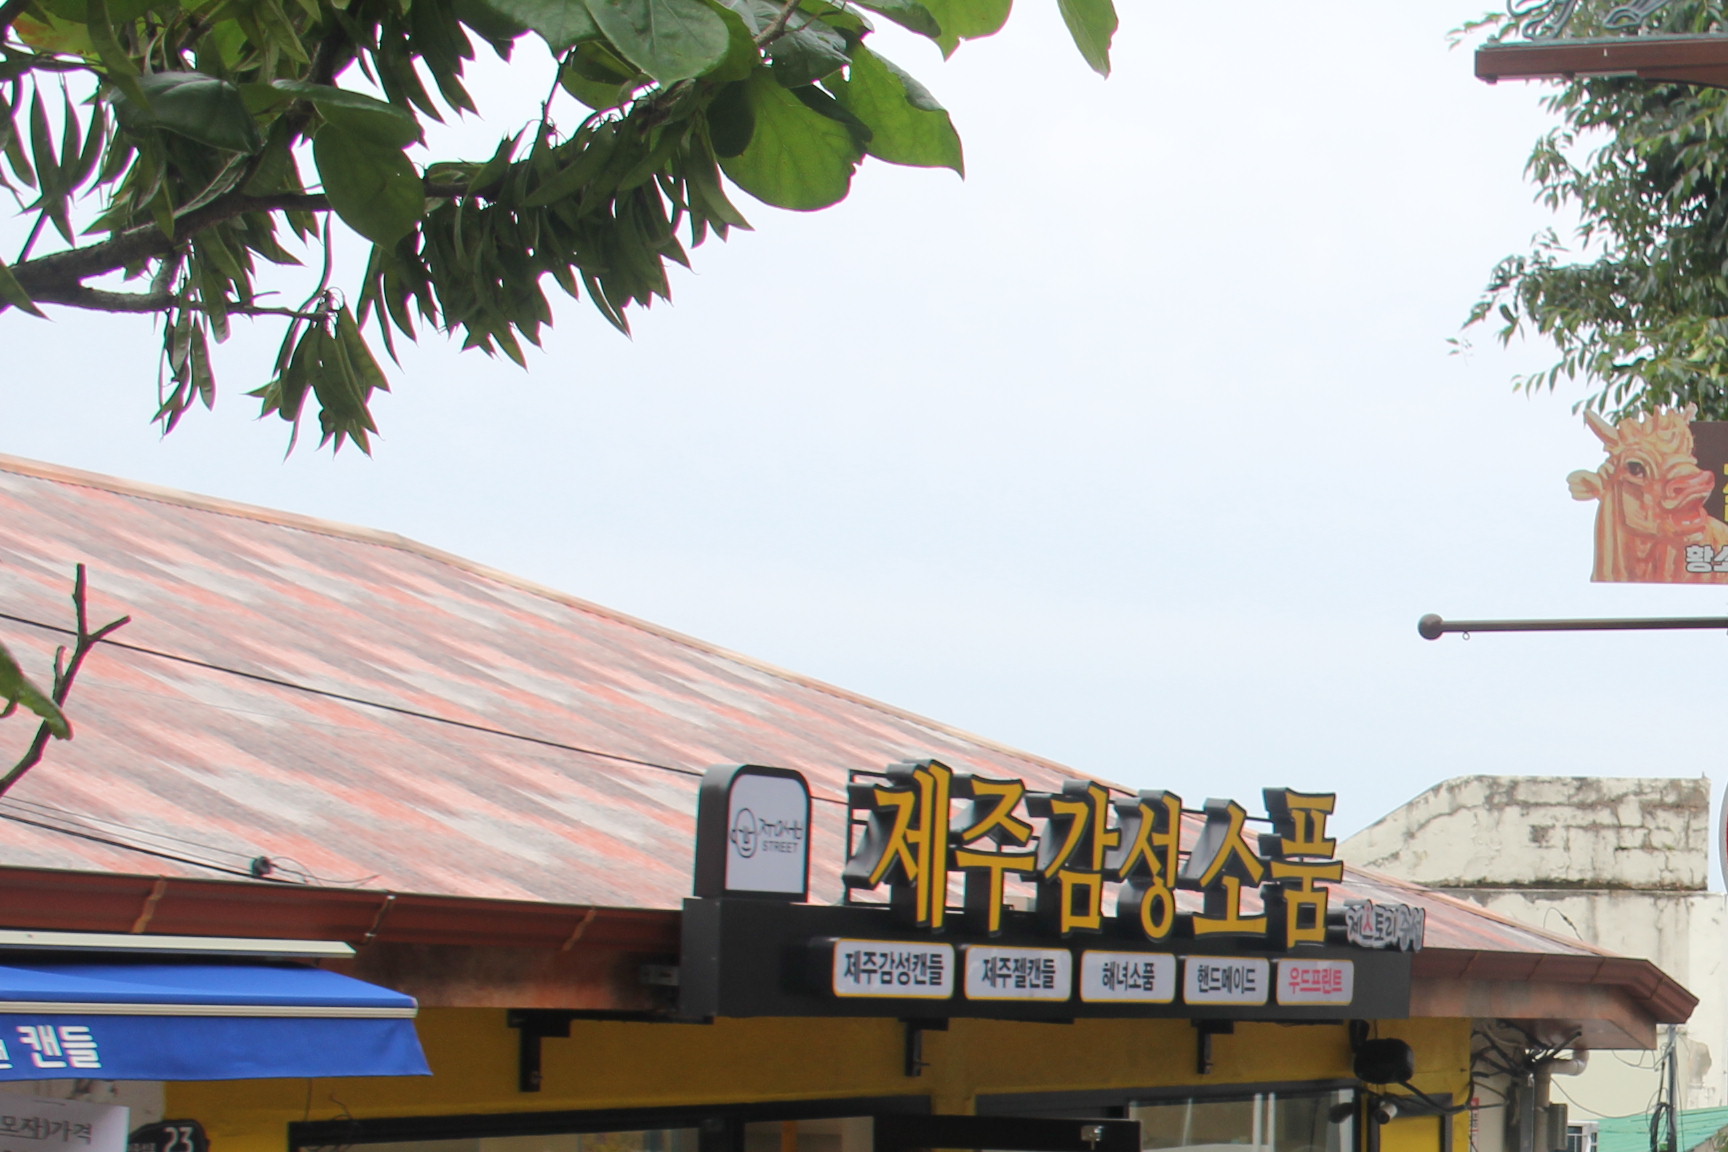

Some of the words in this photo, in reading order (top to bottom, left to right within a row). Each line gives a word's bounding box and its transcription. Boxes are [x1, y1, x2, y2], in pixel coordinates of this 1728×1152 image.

[866, 760, 1345, 950] 제주감성소품
[844, 950, 944, 986] 제주감성캔들
[982, 956, 1056, 989] 제주젤캔들
[1102, 961, 1155, 992] 해녀소품
[1198, 965, 1257, 994] 핸드메이드
[1288, 968, 1343, 994] 우드프린트
[16, 1024, 102, 1069] 캔들
